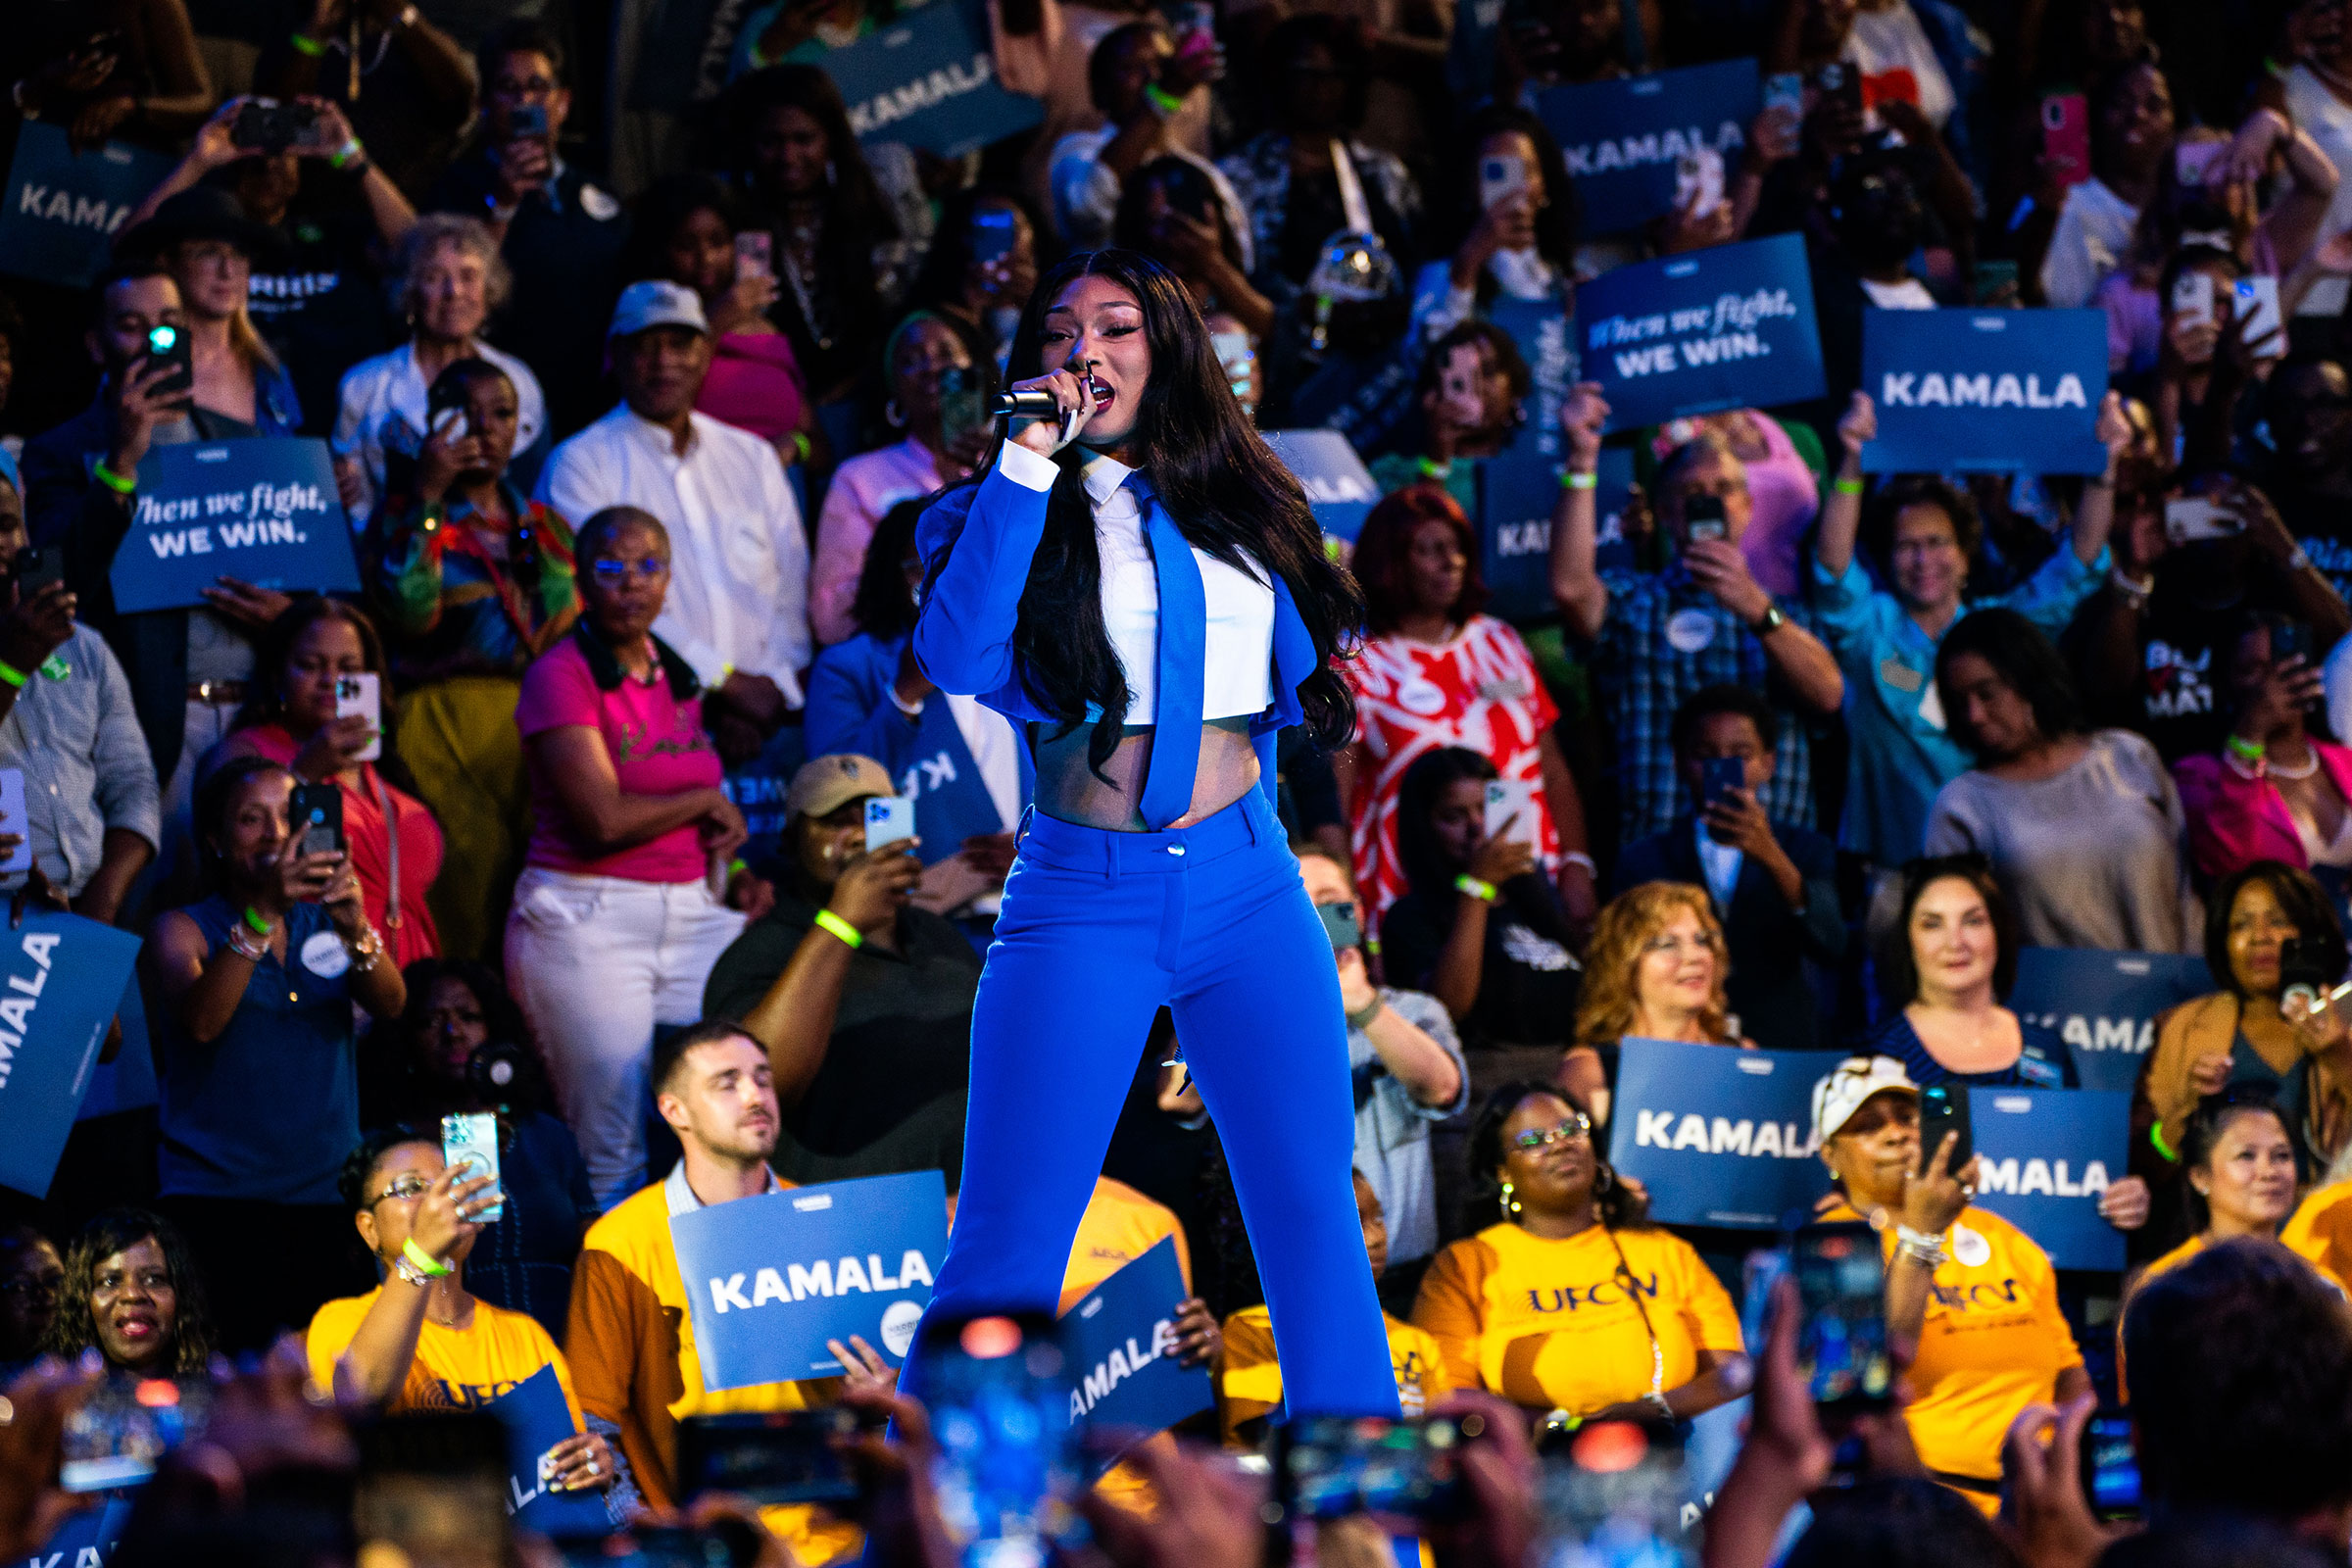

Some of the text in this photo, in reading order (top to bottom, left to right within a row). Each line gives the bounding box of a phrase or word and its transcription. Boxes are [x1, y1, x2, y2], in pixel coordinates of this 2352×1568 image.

[1615, 343, 1678, 379] WE
[1681, 330, 1772, 367] WIN.
[1882, 371, 2087, 409] KAMALA
[205, 491, 246, 517] we
[247, 481, 328, 520] fight,
[149, 517, 308, 560] WE WIN.
[709, 1249, 934, 1315] KAMALA
